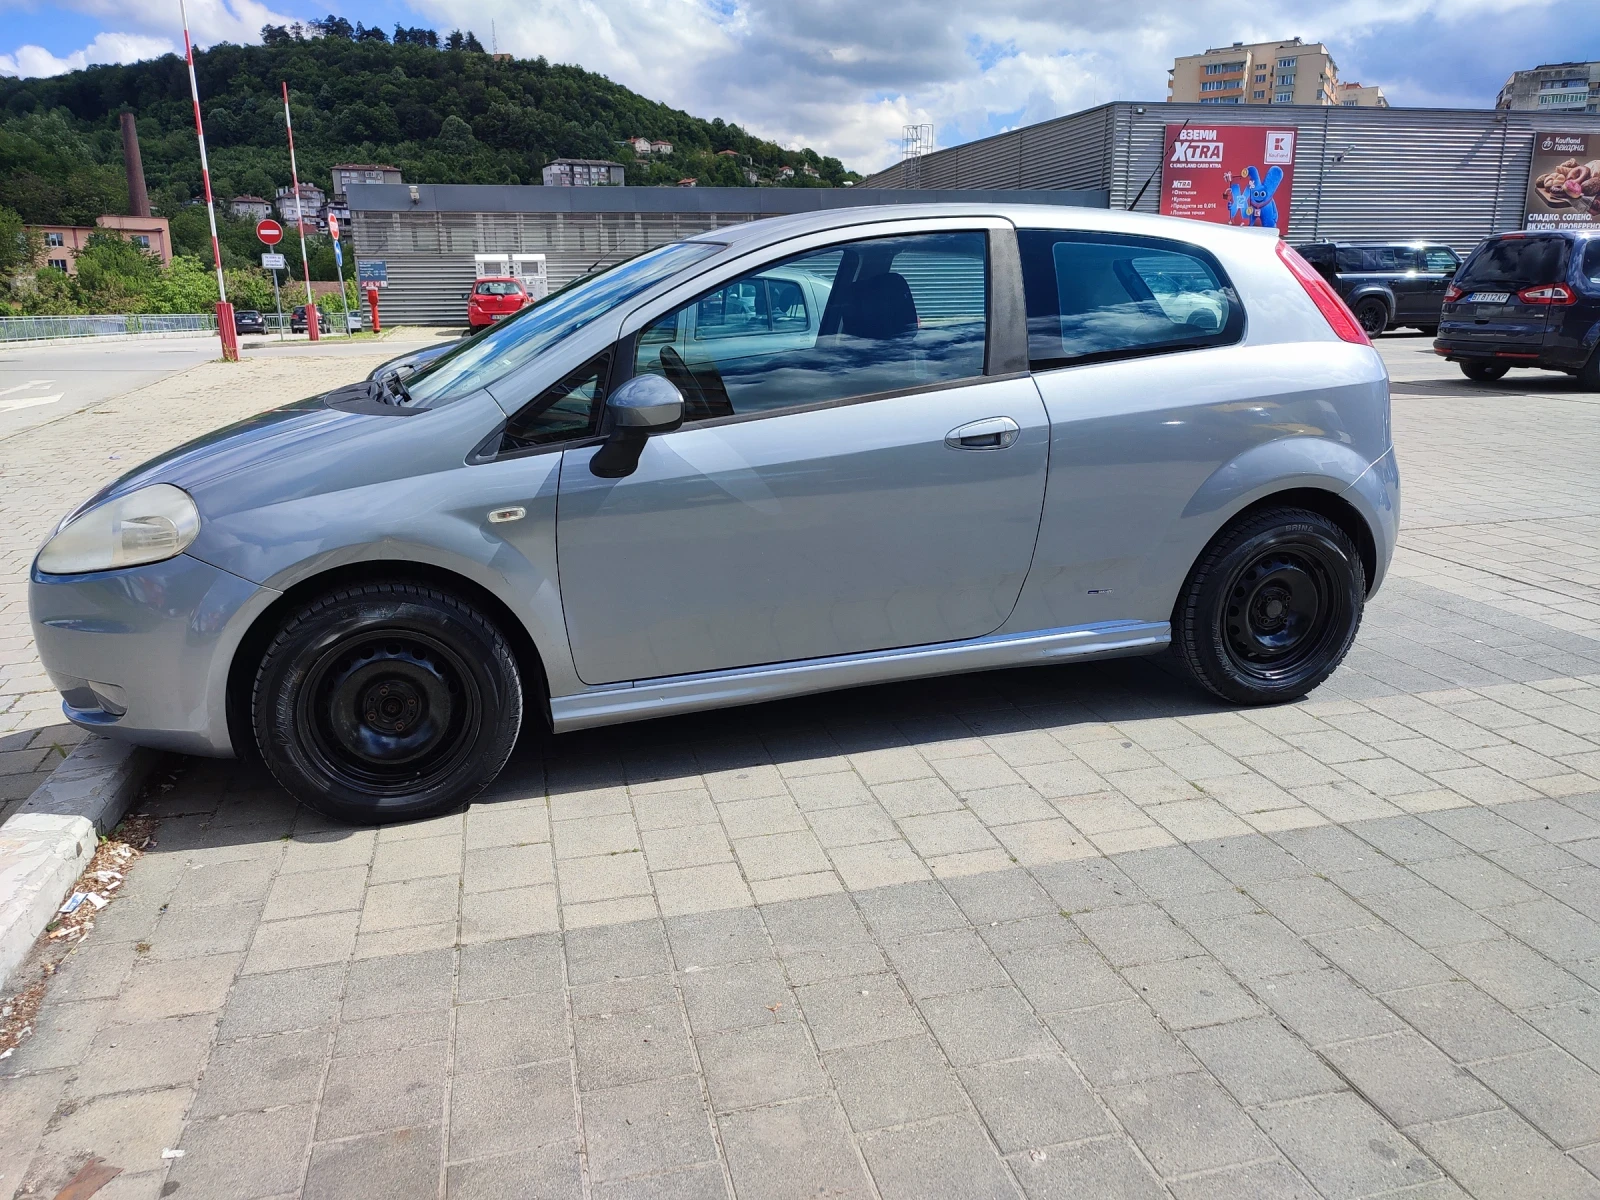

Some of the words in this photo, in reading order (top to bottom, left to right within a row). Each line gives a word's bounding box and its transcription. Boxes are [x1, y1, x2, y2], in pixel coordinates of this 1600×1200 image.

[1180, 129, 1217, 141] ВЗЕМИ
[1170, 142, 1224, 161] XTRA
[1554, 144, 1584, 153] пекарна
[1528, 213, 1561, 222] СЛАДКО.
[1562, 213, 1593, 221] СОЛЕНО.
